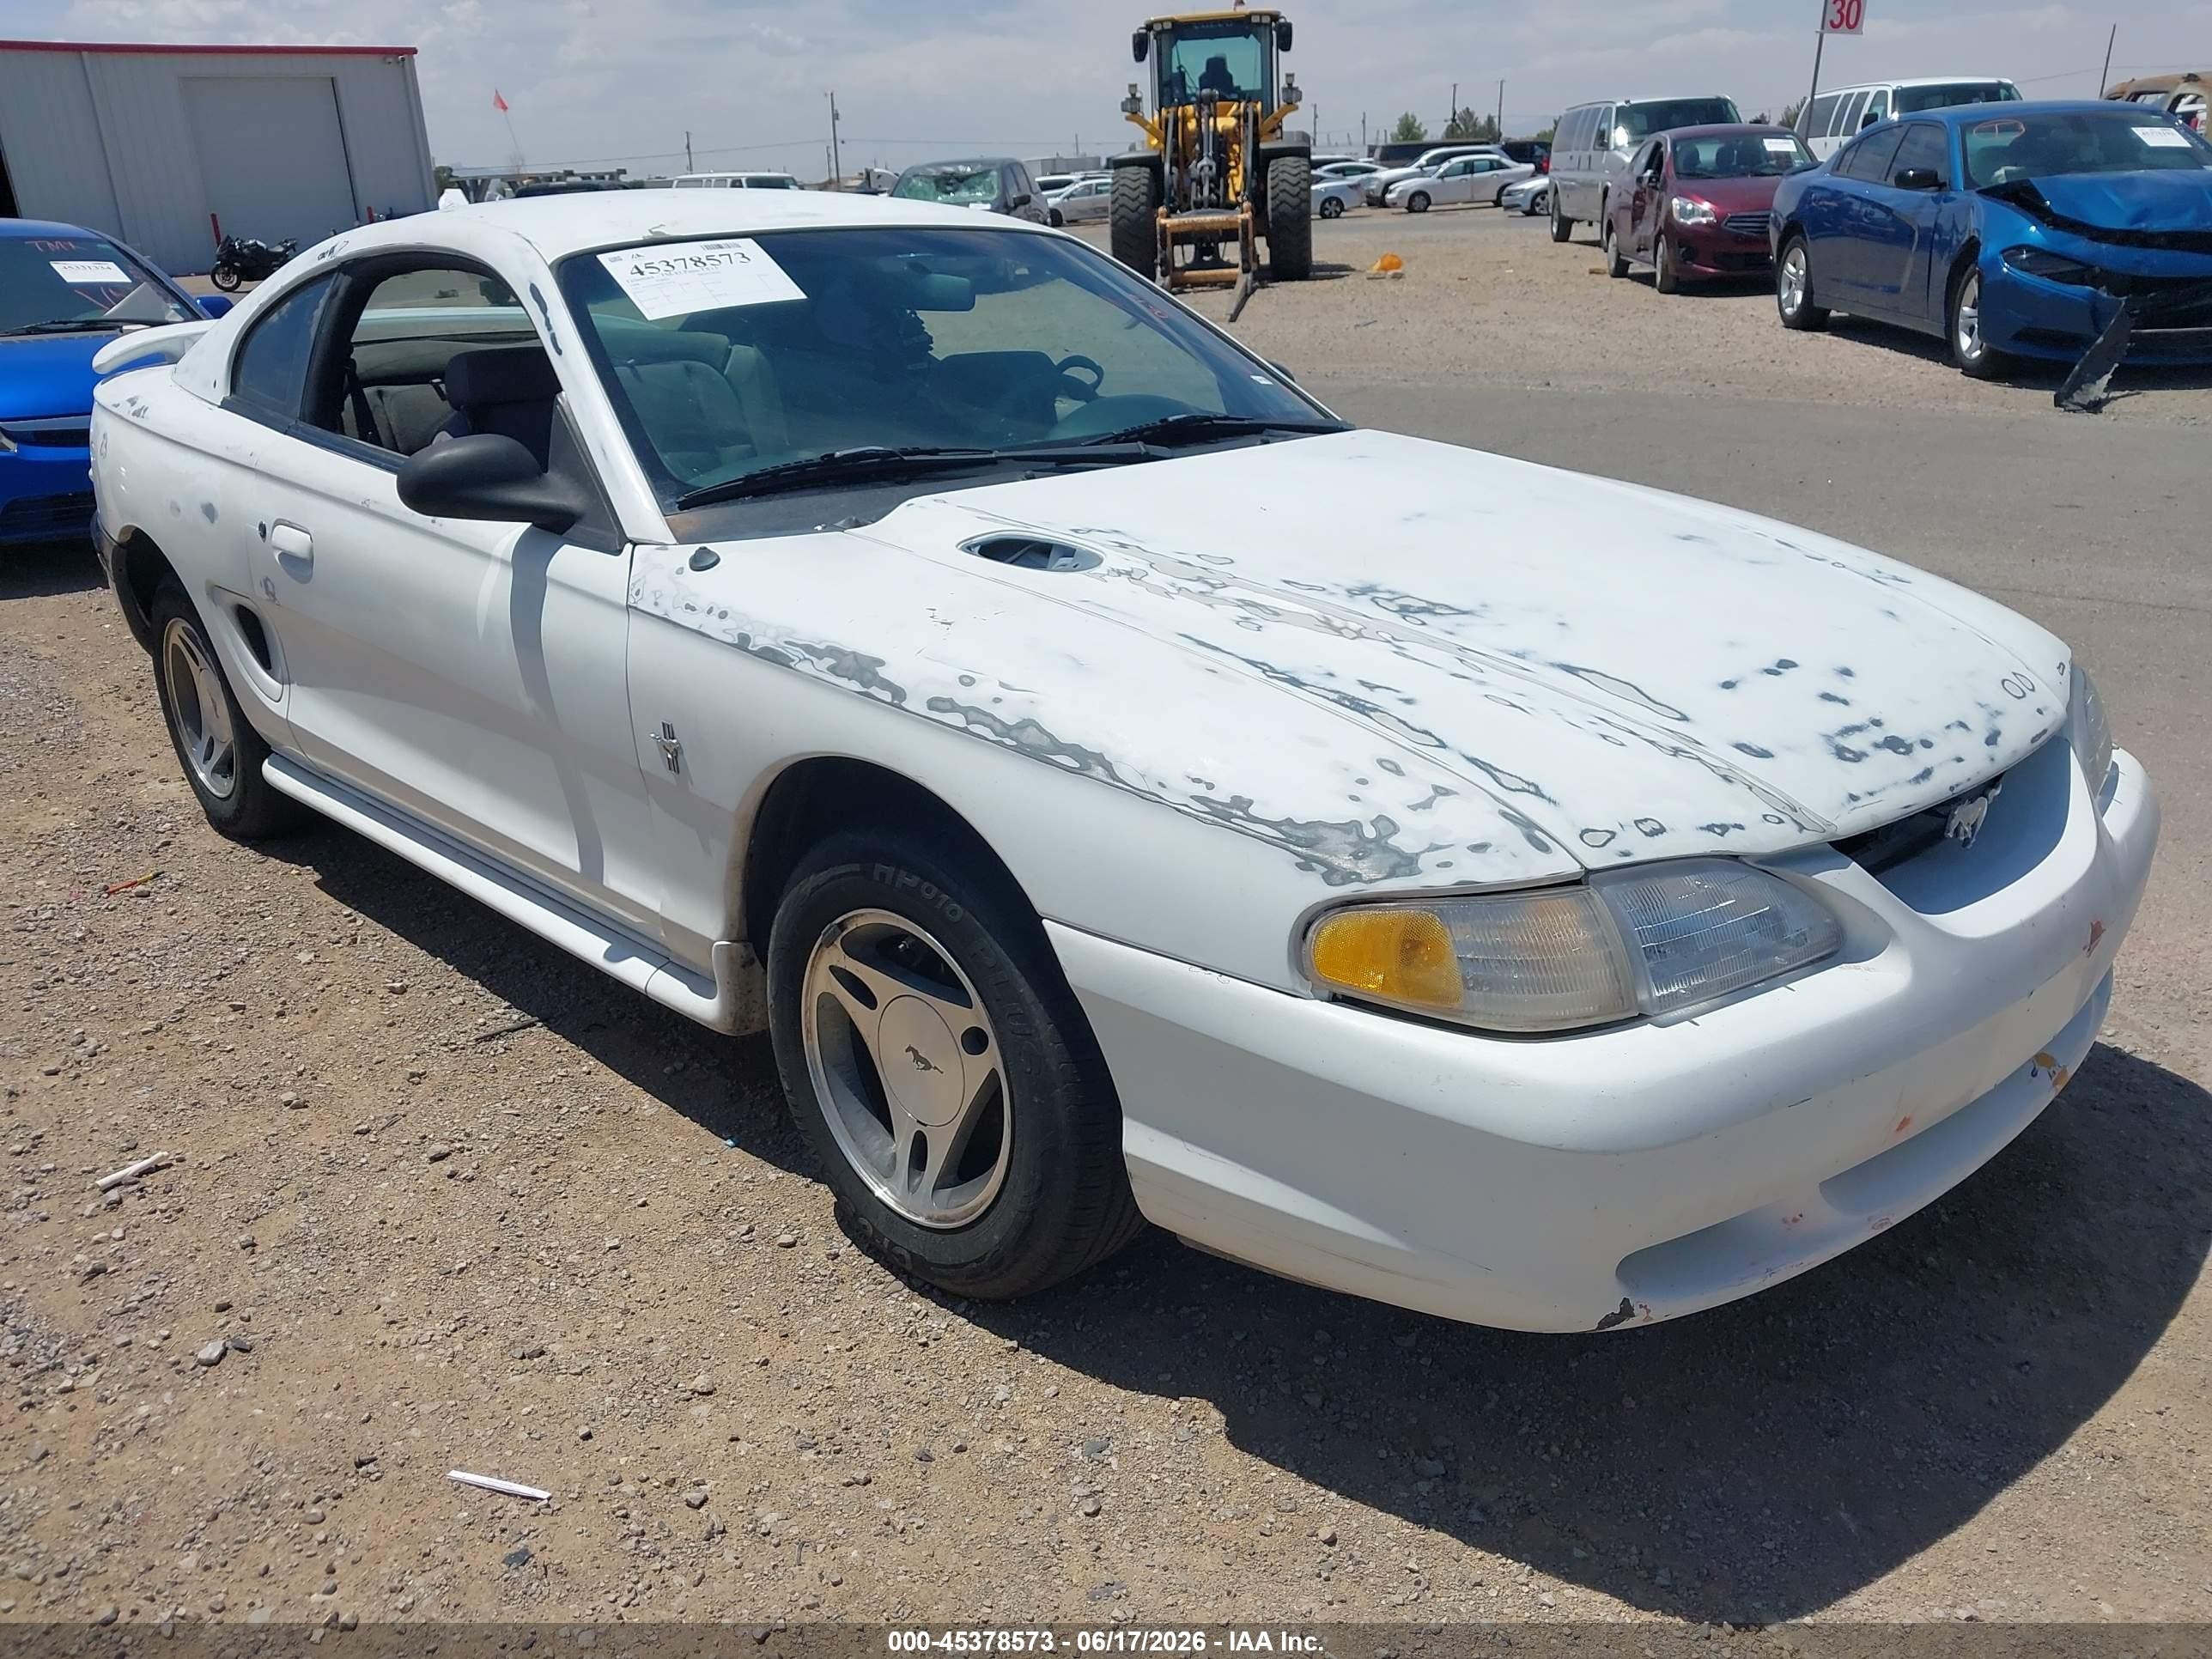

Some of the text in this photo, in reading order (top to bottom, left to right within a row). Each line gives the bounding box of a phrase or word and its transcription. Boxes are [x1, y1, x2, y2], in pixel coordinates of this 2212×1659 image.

[1830, 0, 1862, 29] 30
[630, 252, 751, 276] 45378573
[873, 863, 963, 922] HP010
